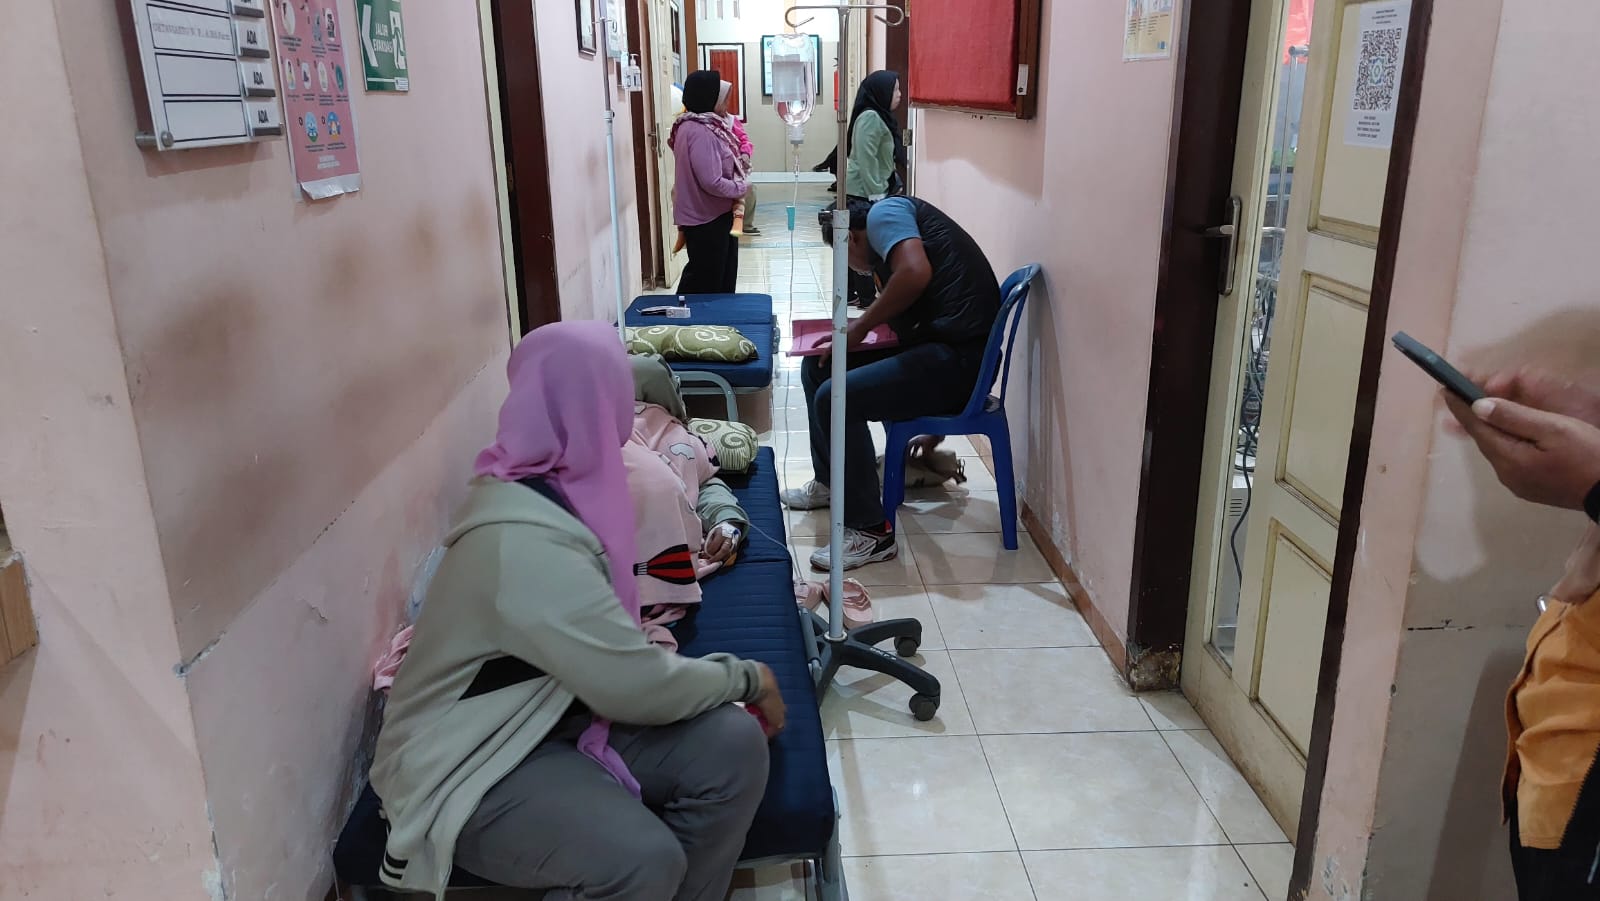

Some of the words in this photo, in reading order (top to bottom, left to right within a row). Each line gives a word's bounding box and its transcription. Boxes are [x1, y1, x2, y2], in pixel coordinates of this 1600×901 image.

[247, 29, 257, 45] ADA
[253, 71, 264, 86] ADA
[258, 110, 269, 124] ADA
